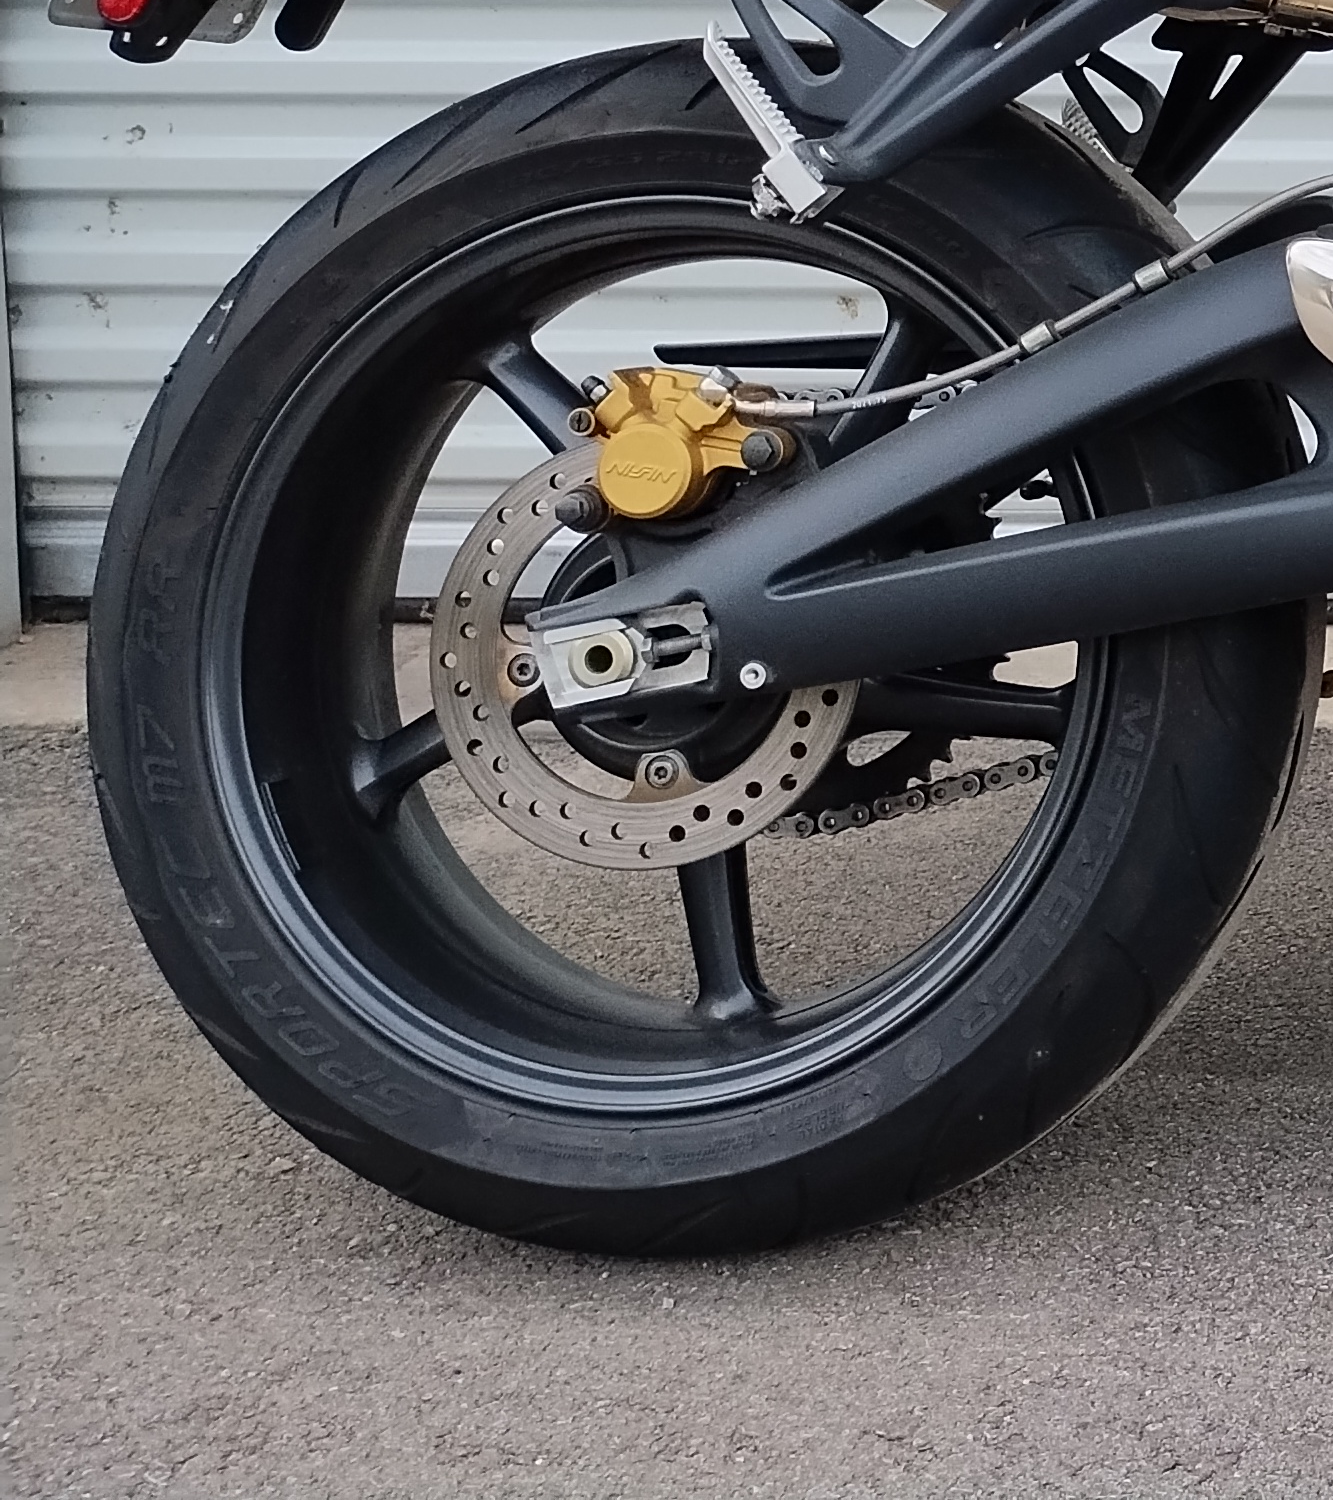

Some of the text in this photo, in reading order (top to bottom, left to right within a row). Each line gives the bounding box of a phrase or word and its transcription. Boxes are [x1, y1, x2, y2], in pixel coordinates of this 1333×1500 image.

[605, 461, 677, 484] NISSIN
[158, 837, 437, 1109] SPORTEC
[951, 692, 1151, 1039] METZELER
